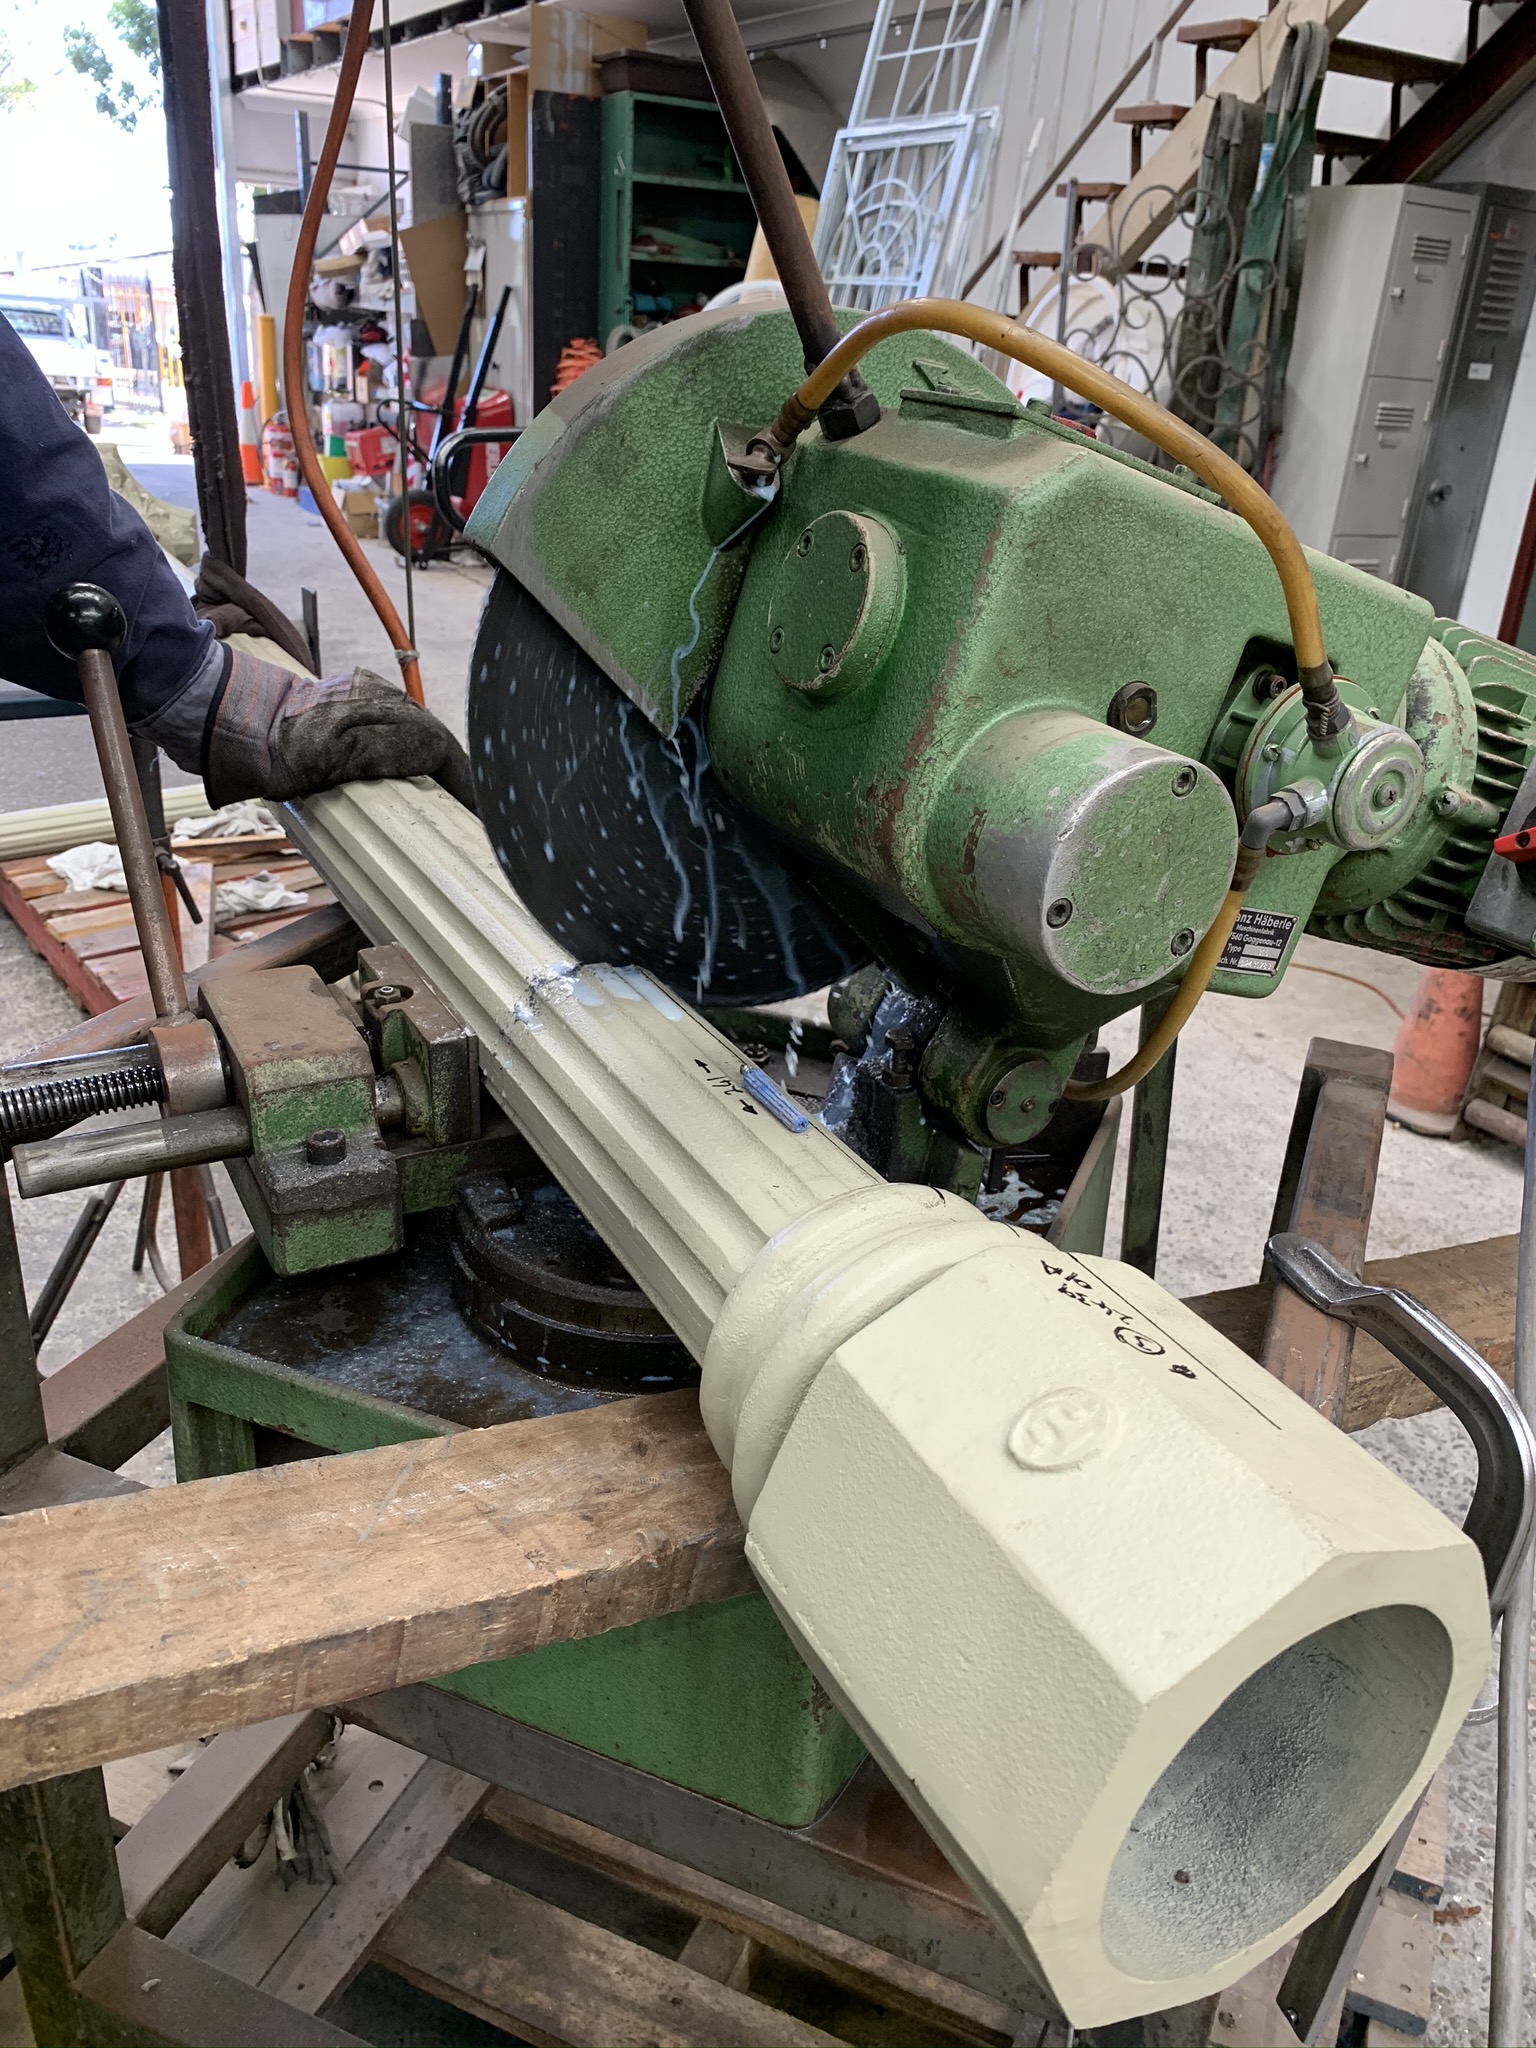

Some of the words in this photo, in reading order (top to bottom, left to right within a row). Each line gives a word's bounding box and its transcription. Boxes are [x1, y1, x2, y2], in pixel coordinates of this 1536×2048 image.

[1236, 913, 1253, 922] anz
[1253, 913, 1292, 930] Häberle
[1227, 943, 1242, 953] Type
